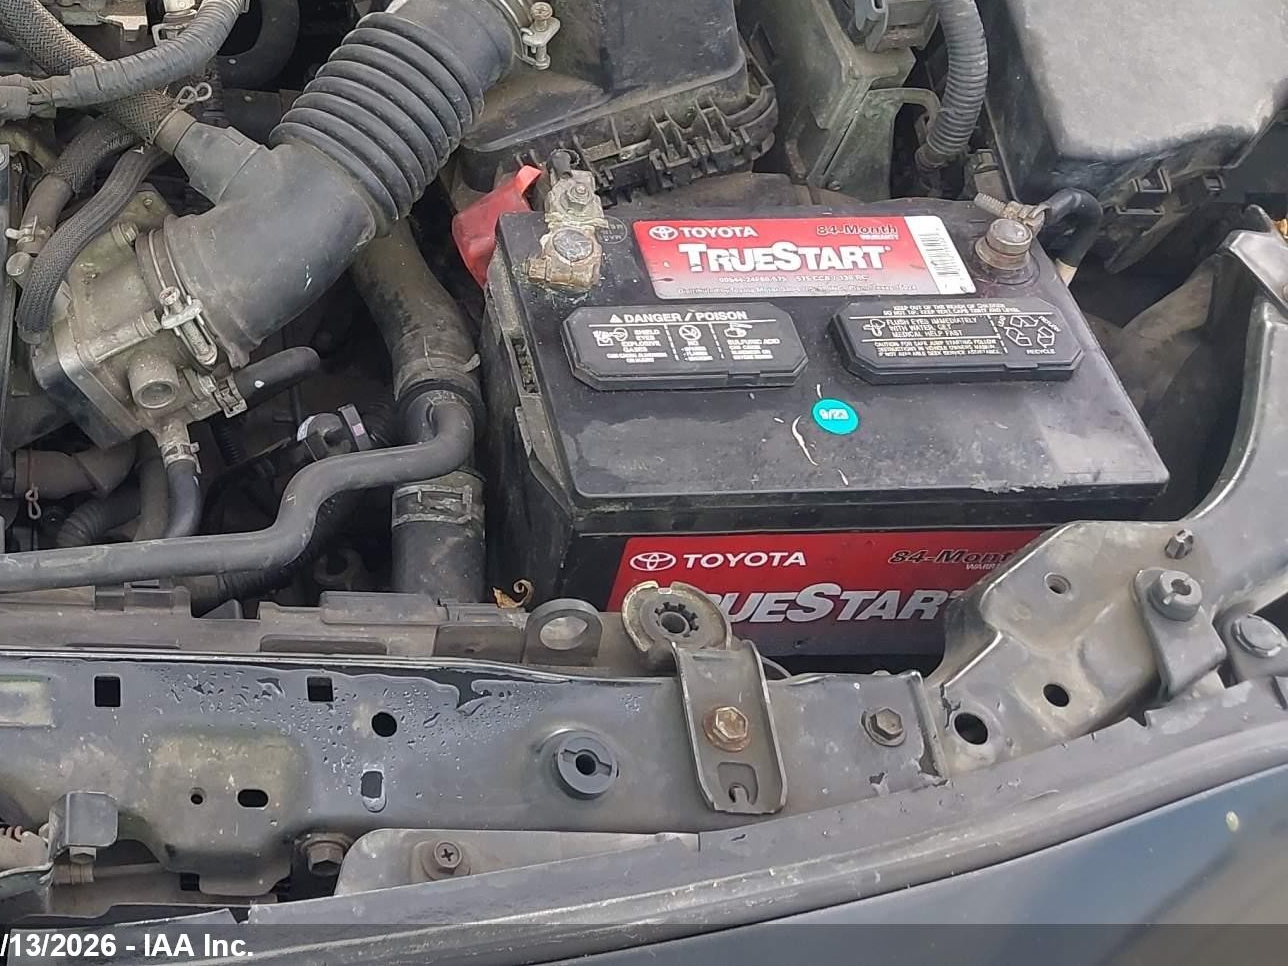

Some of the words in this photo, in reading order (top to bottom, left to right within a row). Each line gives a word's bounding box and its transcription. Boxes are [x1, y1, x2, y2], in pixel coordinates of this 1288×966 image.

[678, 226, 758, 238] TOYOTA
[817, 224, 898, 236] 84-Month
[623, 312, 682, 323] DANGER
[695, 310, 749, 321] POISON
[885, 318, 910, 326] FLUSH
[683, 551, 807, 569] TOYOTA
